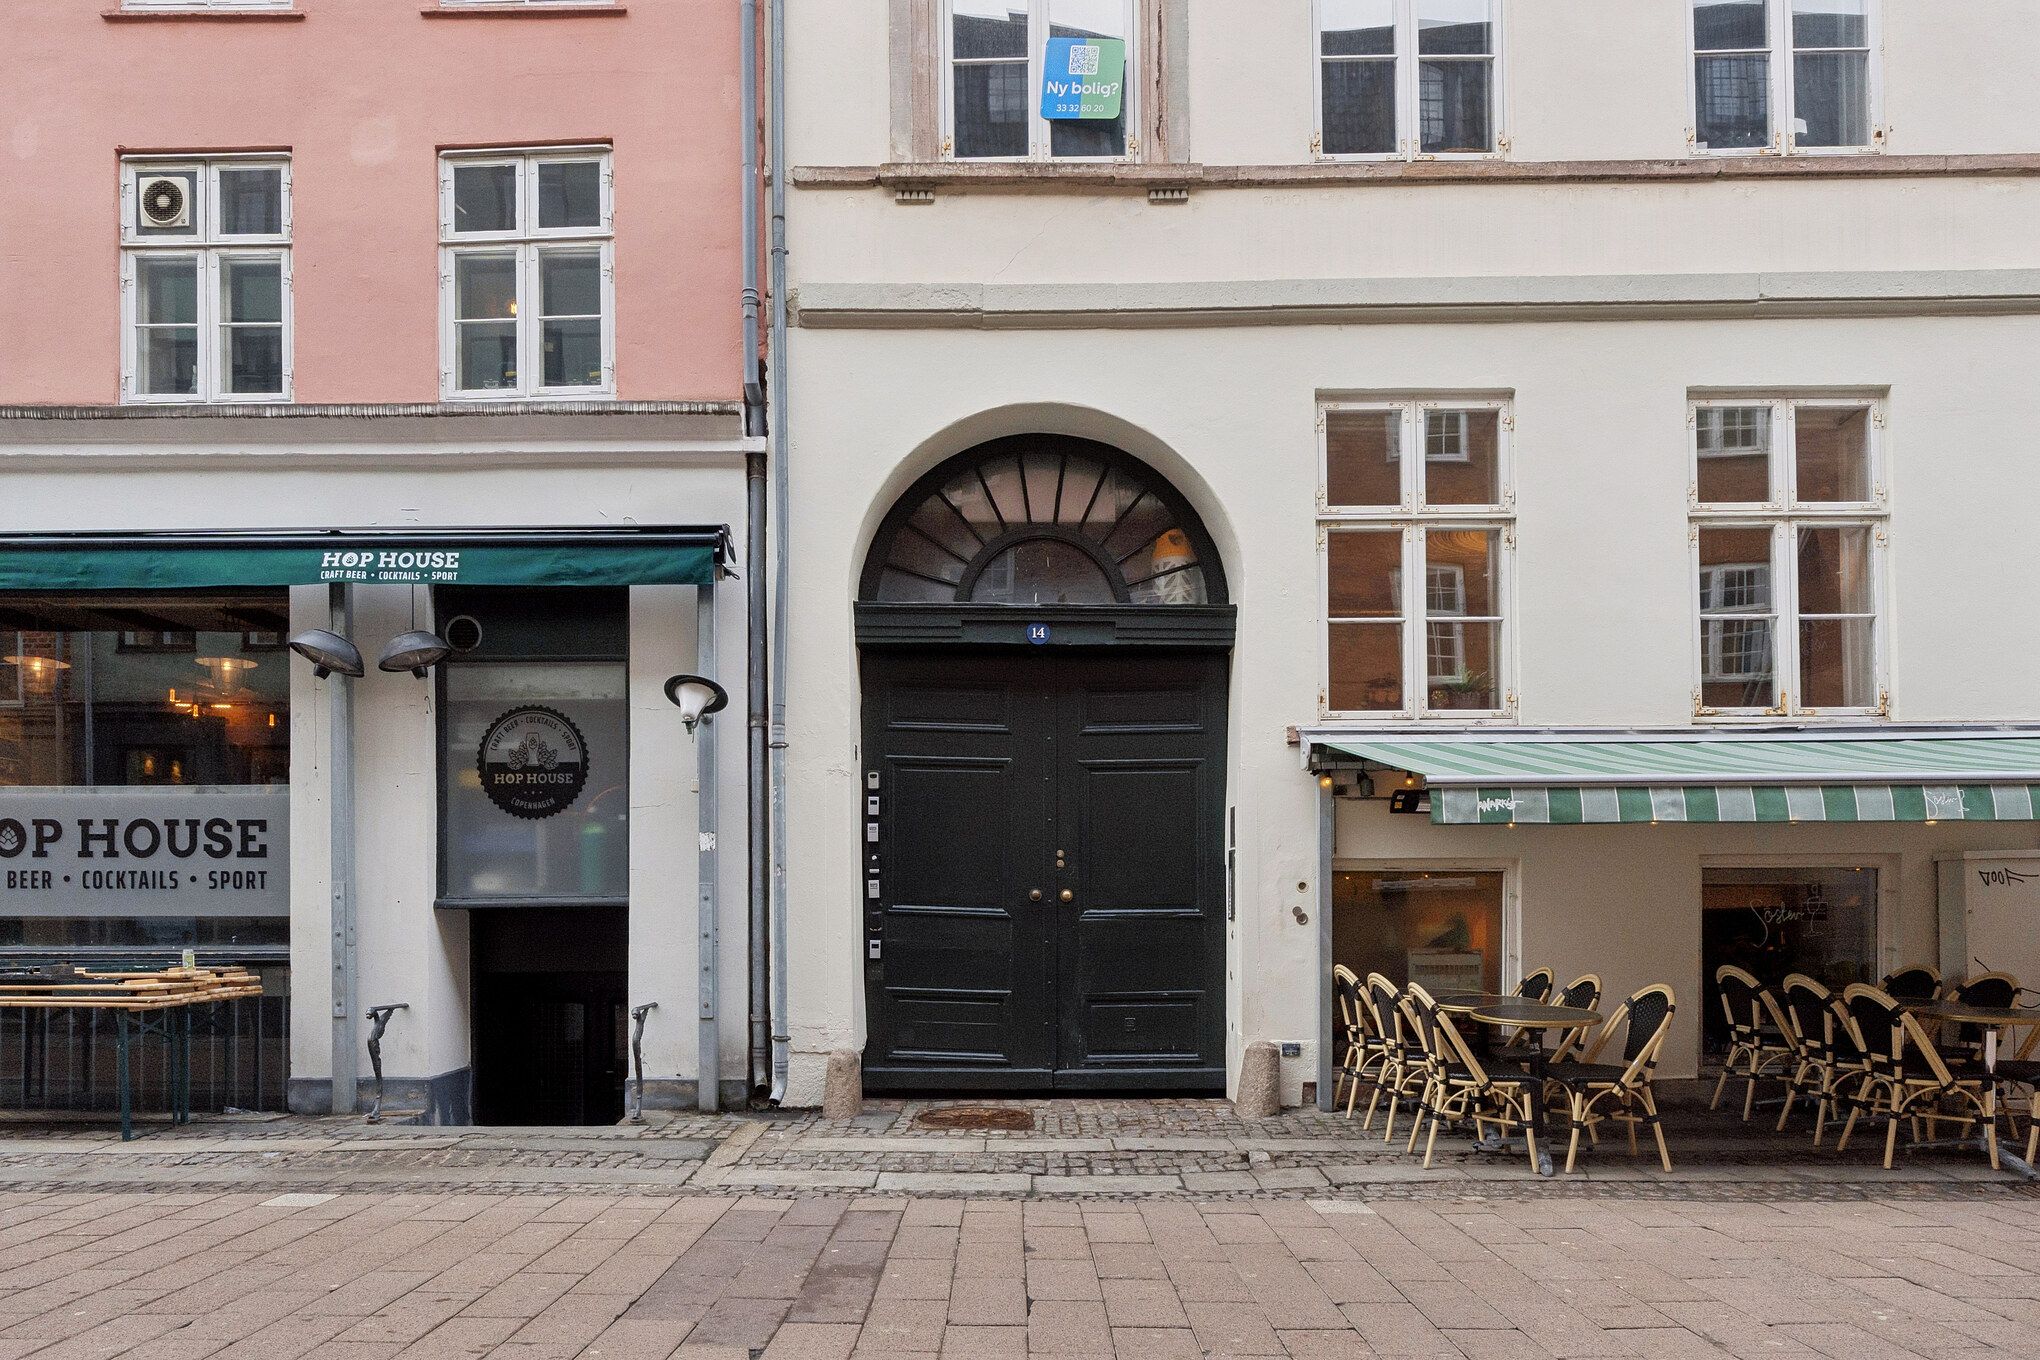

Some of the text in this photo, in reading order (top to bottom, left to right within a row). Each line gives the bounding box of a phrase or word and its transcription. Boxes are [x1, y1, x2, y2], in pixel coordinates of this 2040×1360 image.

[1046, 81, 1119, 97] Ny bolig?
[1056, 104, 1104, 112] 33 32 60 20
[321, 552, 460, 568] HOP HOUSE
[320, 570, 458, 581] CRAFT BEER COCKTAILS SPORT
[1032, 627, 1045, 639] 14
[490, 716, 577, 751] CRAFT BEER COCKTAILS SPORT
[494, 773, 574, 784] HOP HOUSE
[511, 797, 555, 810] COPENHAGEN
[77, 818, 268, 858] HOUSE
[7, 870, 268, 890] BEER COCKTAILS SPORT
